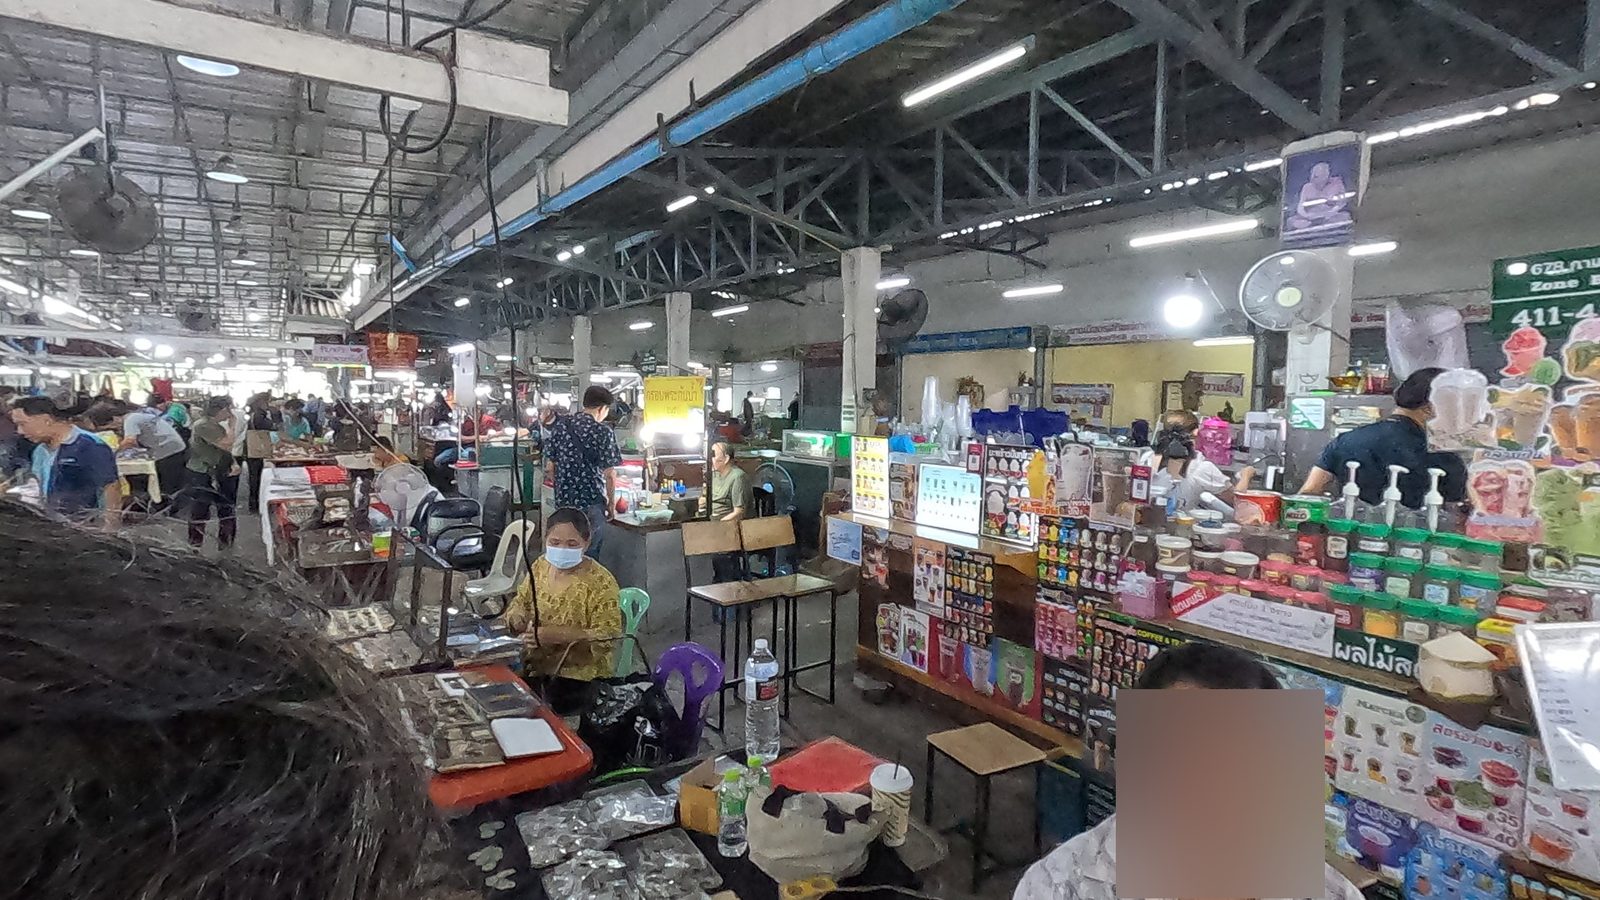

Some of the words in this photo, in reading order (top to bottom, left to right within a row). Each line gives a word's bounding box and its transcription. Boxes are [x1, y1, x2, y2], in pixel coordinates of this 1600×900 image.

[1530, 279, 1579, 292] Zone
[1511, 303, 1600, 327] 411-4
[1137, 629, 1164, 643] COFFEE
